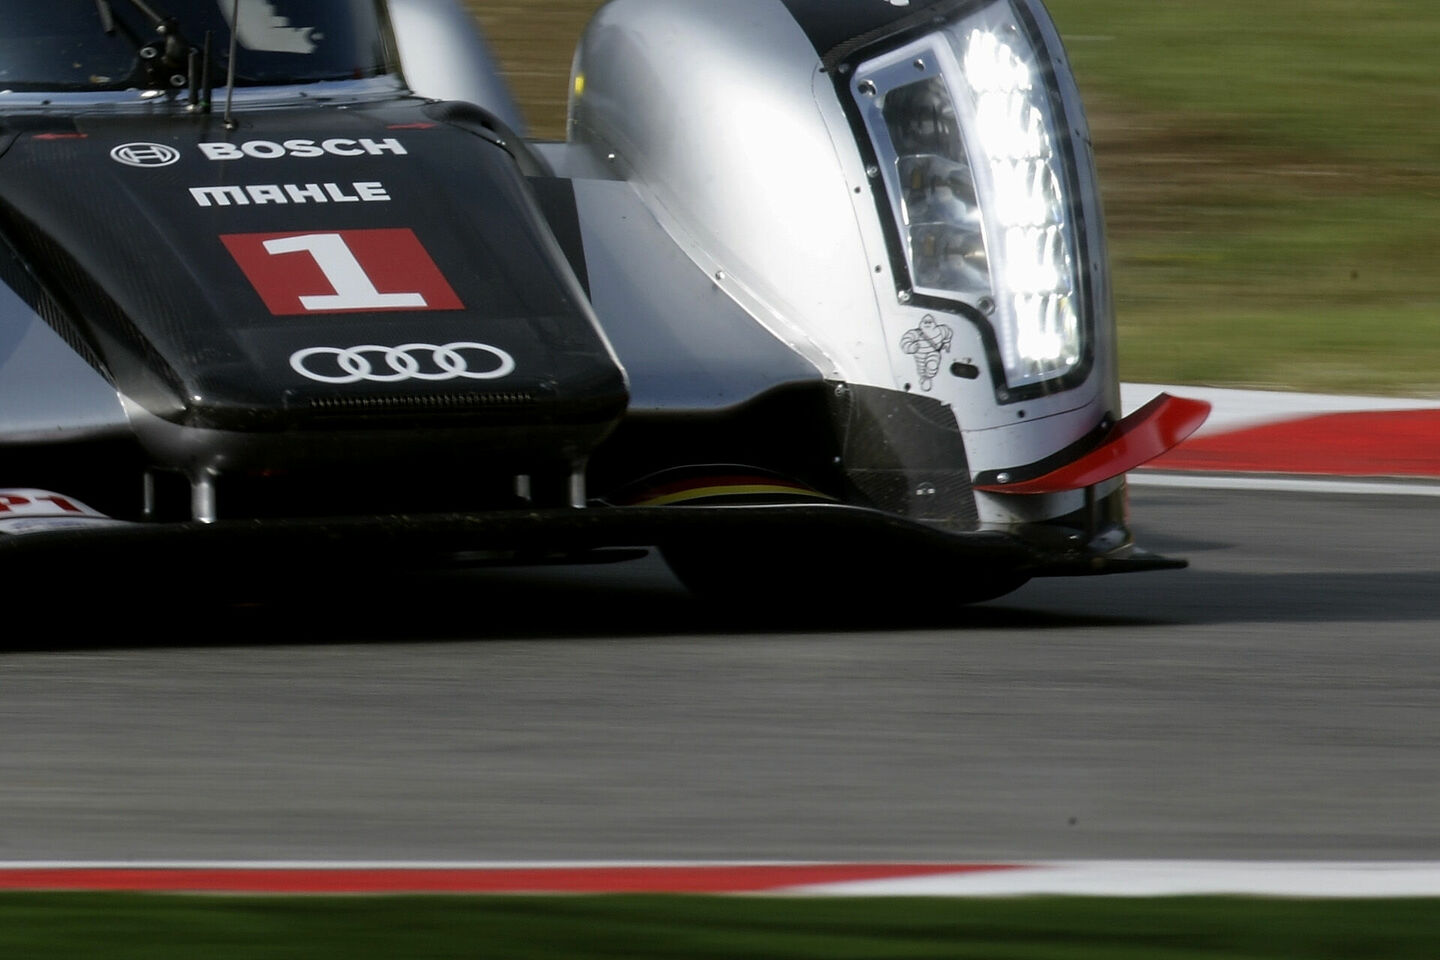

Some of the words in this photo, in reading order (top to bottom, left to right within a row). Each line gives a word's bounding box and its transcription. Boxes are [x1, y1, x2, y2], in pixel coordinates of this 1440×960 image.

[197, 138, 408, 161] BOSCH
[188, 182, 391, 207] MAHLE
[262, 233, 428, 311] 1
